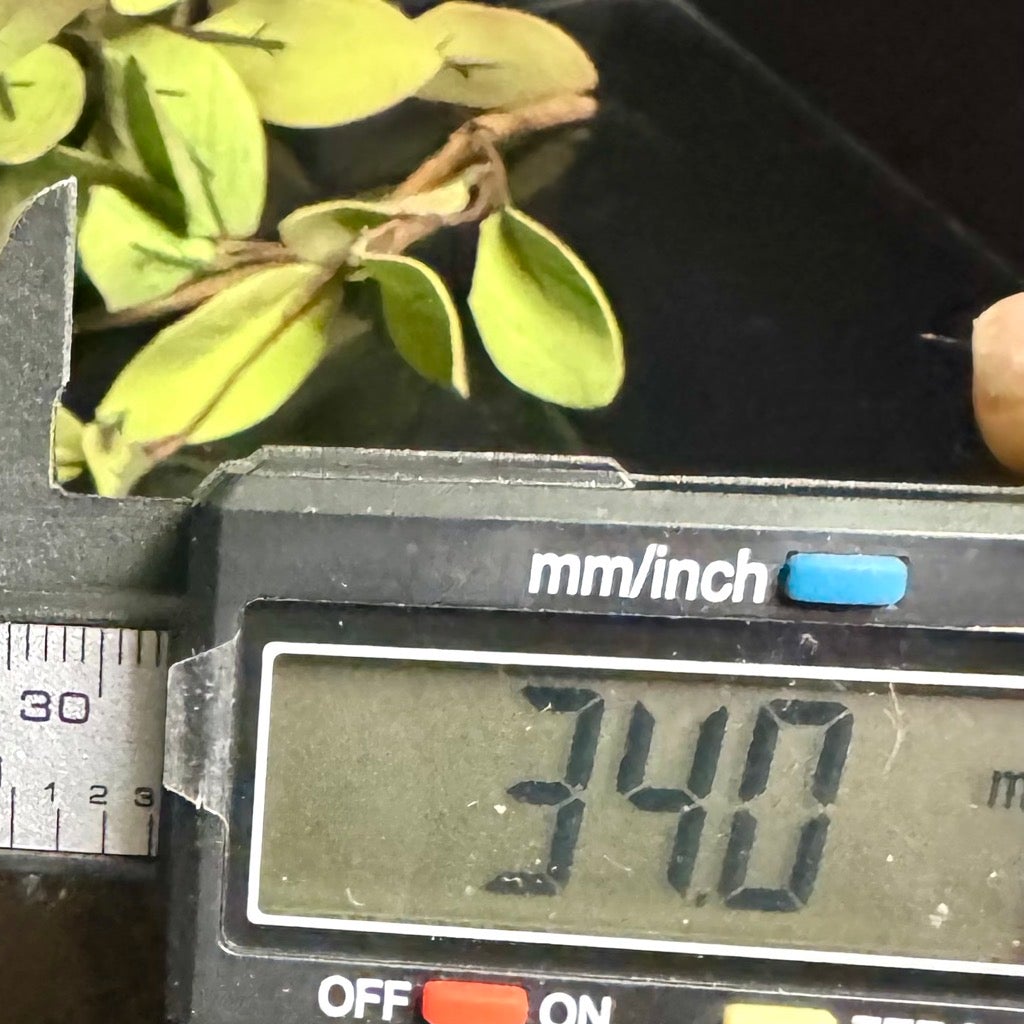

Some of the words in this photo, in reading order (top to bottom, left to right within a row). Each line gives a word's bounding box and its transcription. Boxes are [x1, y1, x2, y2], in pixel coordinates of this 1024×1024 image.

[527, 544, 769, 604] mm/inch
[19, 690, 90, 724] 30
[44, 782, 56, 802] 1
[89, 785, 108, 805] 2
[134, 787, 154, 807] 3
[317, 974, 413, 1022] OFF
